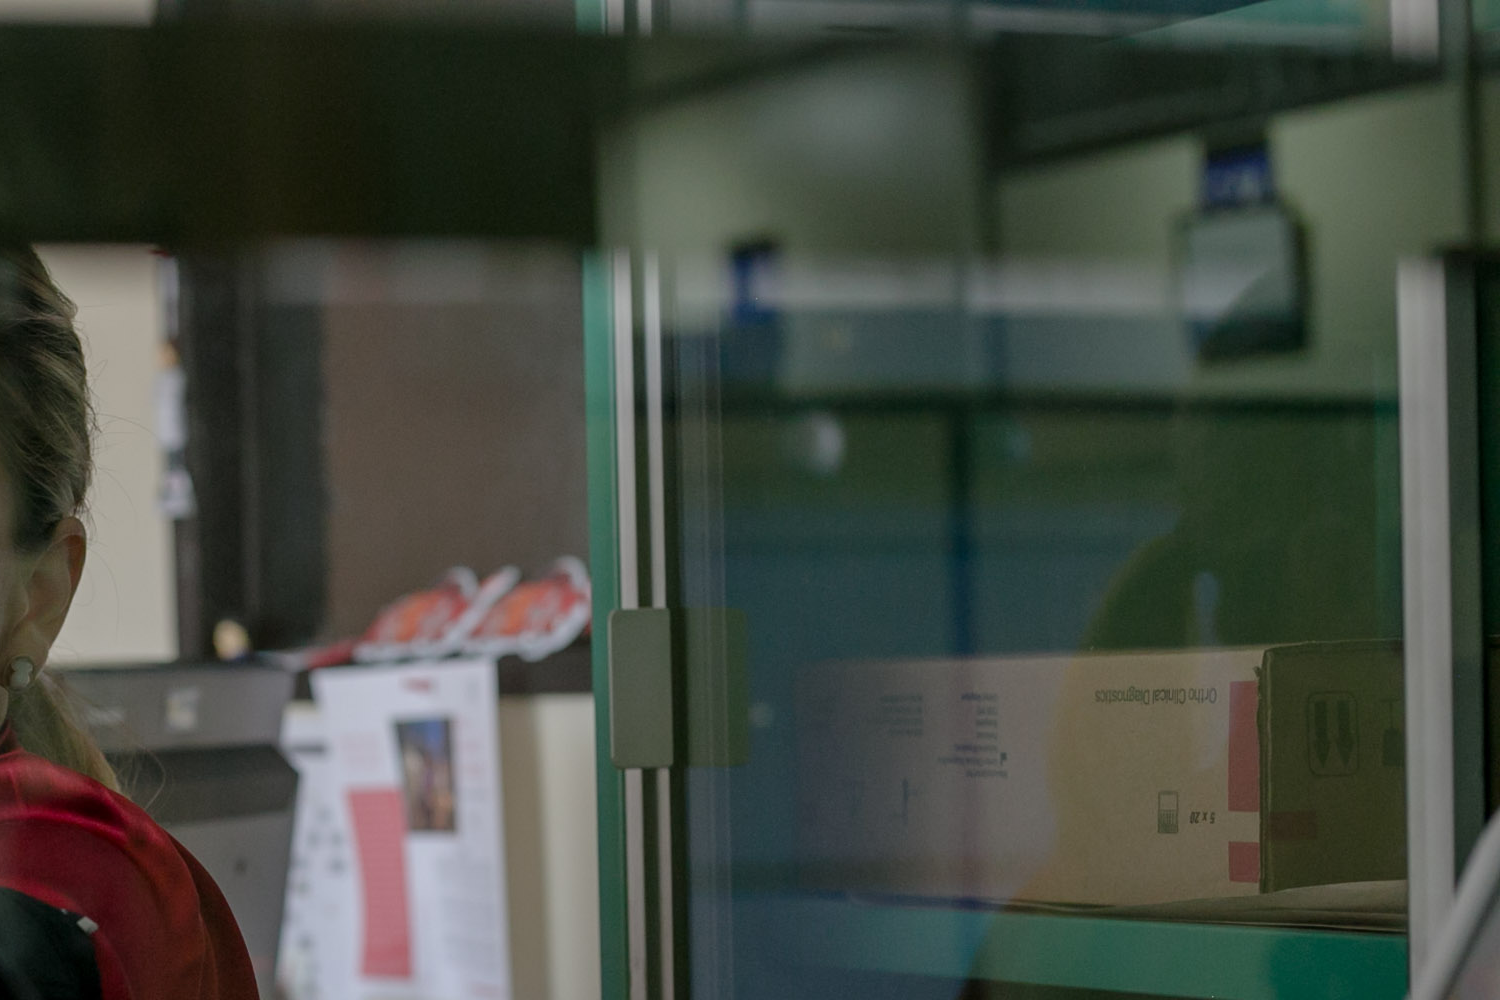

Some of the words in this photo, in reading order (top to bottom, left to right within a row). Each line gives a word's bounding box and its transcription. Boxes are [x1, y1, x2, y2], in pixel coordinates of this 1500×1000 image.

[1095, 686, 1150, 705] Diagnostics
[1152, 687, 1186, 705] Clinical
[1188, 687, 1218, 704] Ortho
[1190, 811, 1201, 824] 20
[1209, 811, 1216, 824] 5
